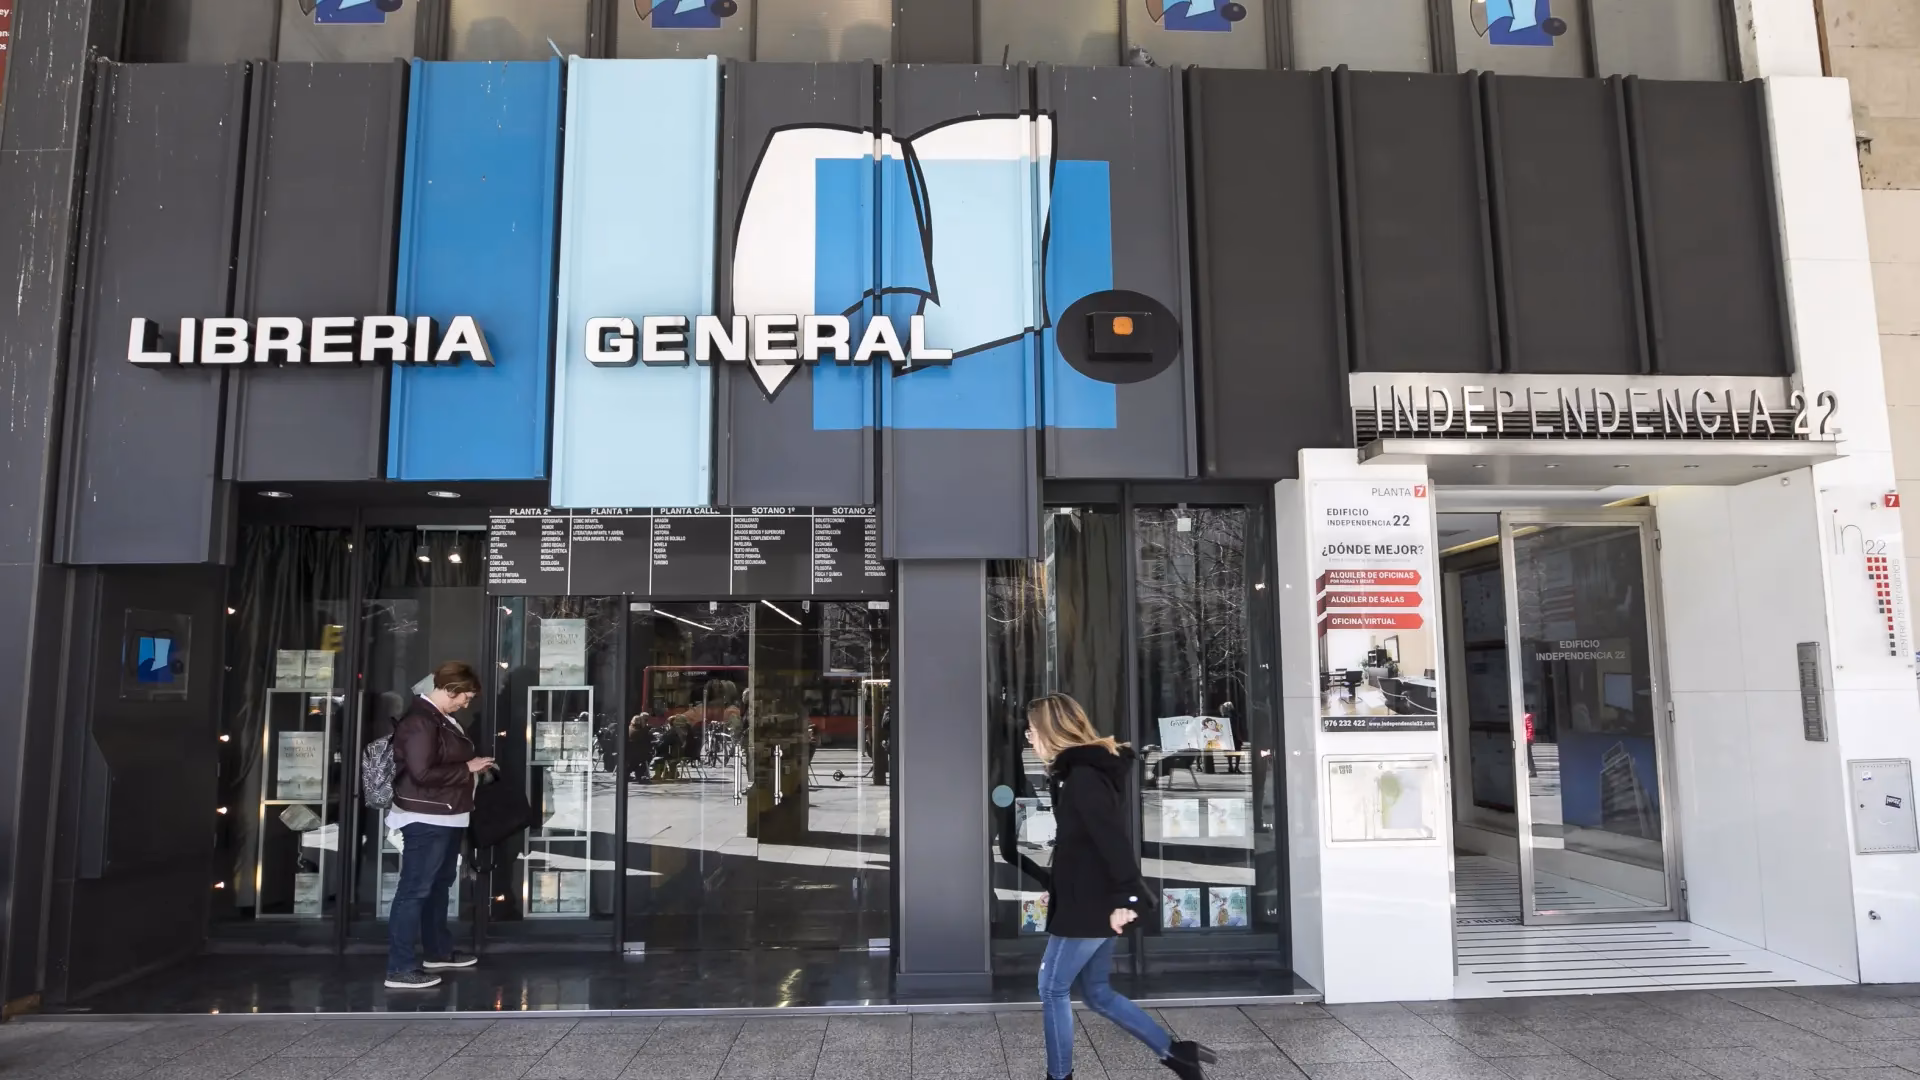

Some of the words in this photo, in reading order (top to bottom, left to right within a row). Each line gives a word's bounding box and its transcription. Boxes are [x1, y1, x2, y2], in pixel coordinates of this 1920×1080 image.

[127, 315, 491, 365] LIBRERIA
[584, 314, 953, 364] GENERAL
[1373, 384, 1777, 433] INDEPENDENCIA
[1790, 389, 1841, 435] 22
[1371, 487, 1411, 497] PLANTA
[1417, 486, 1425, 497] 7
[1887, 495, 1896, 507] 7
[509, 508, 542, 516] PLANTA
[590, 507, 623, 515] PLANTA
[660, 507, 692, 515] PLANTA
[1326, 508, 1369, 516] EDIFICIO
[1327, 519, 1392, 527] INDEPENDENCIA
[1392, 514, 1411, 527] 22
[1321, 542, 1371, 557] ¿DÓNDE
[1374, 544, 1425, 555] MEJOR?
[1330, 571, 1366, 579] ALQUILER
[1367, 571, 1378, 579] DE
[1378, 571, 1414, 579] OFICINAS
[1559, 639, 1600, 649] EDIFICIO
[1535, 651, 1613, 661] INDEPENDENCIA
[1614, 651, 1626, 659] 22
